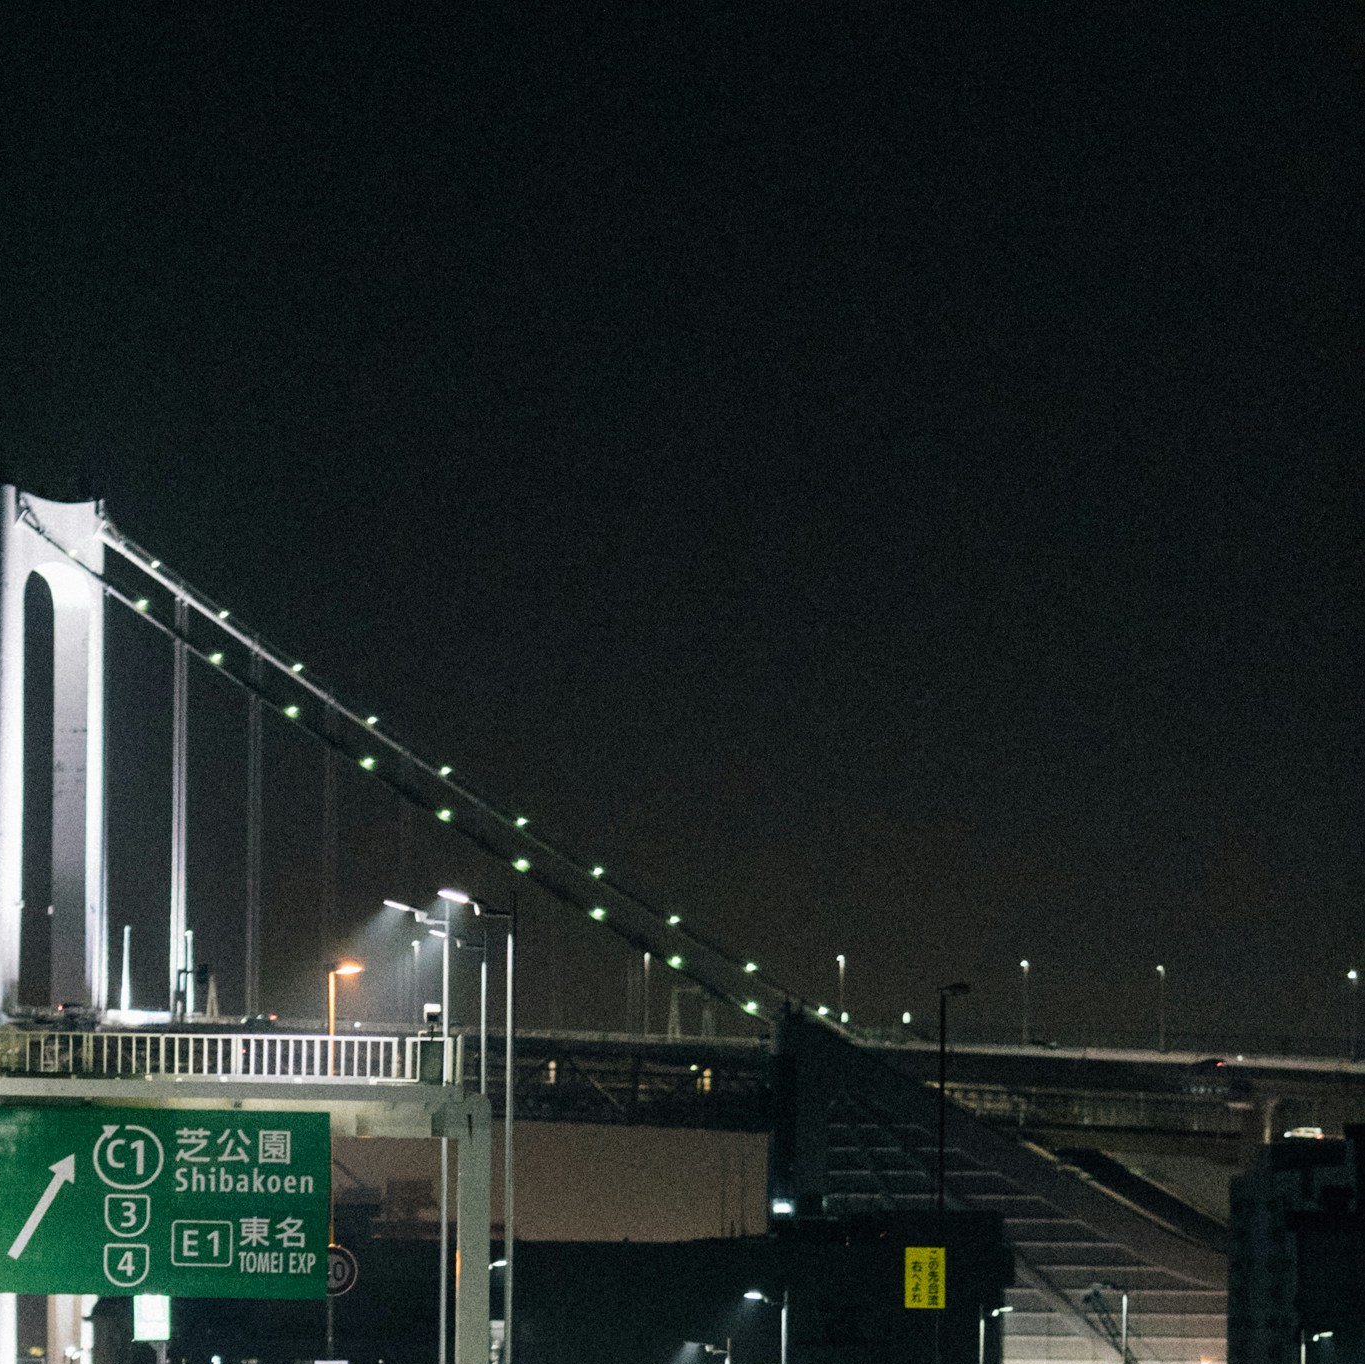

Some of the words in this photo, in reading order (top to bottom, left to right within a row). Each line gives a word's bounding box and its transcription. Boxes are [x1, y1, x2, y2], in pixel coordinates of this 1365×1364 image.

[106, 1138, 145, 1175] C1
[175, 1128, 291, 1165] 芝公園
[175, 1167, 314, 1193] Shibakoen
[120, 1201, 137, 1227] 3
[183, 1230, 219, 1257] E1
[239, 1216, 306, 1248] 東名
[117, 1251, 136, 1277] 4
[238, 1252, 284, 1274] TOMEI
[288, 1253, 316, 1274] EXP
